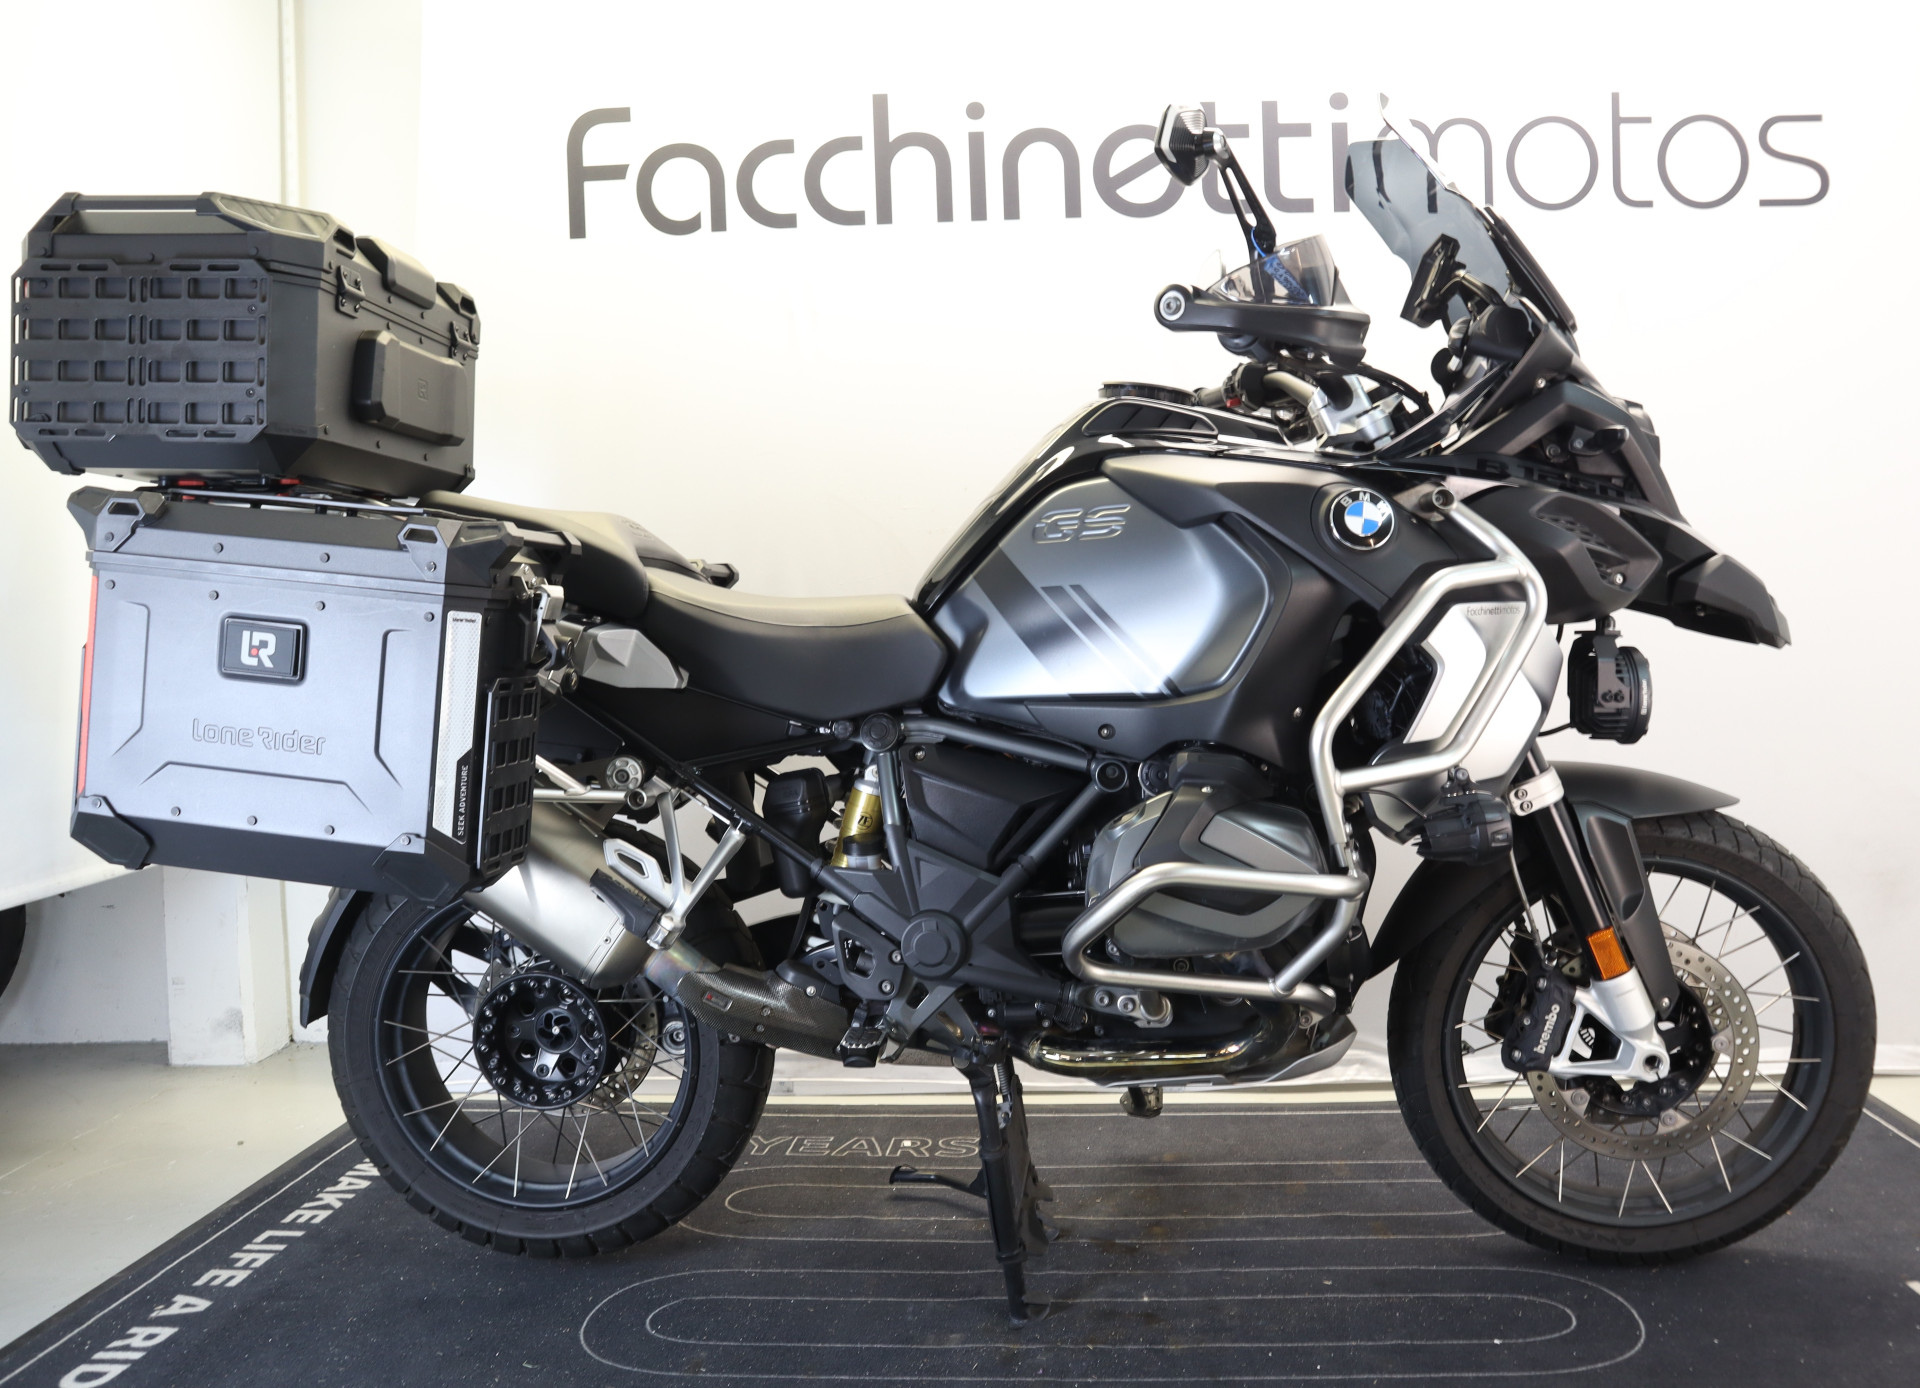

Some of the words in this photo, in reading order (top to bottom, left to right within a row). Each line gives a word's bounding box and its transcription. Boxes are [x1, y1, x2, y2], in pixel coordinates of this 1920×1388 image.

[1032, 503, 1131, 544] GS
[1340, 491, 1393, 520] BMW
[192, 717, 255, 748] Lone
[257, 726, 327, 755] Rider
[459, 764, 469, 814] ADVENTURE
[457, 814, 466, 836] SEEK
[1533, 1003, 1560, 1055] brembo
[749, 1135, 980, 1158] YEARS
[280, 1157, 381, 1224] MAKE
[191, 1230, 306, 1288] LIFE
[148, 1294, 214, 1320] A
